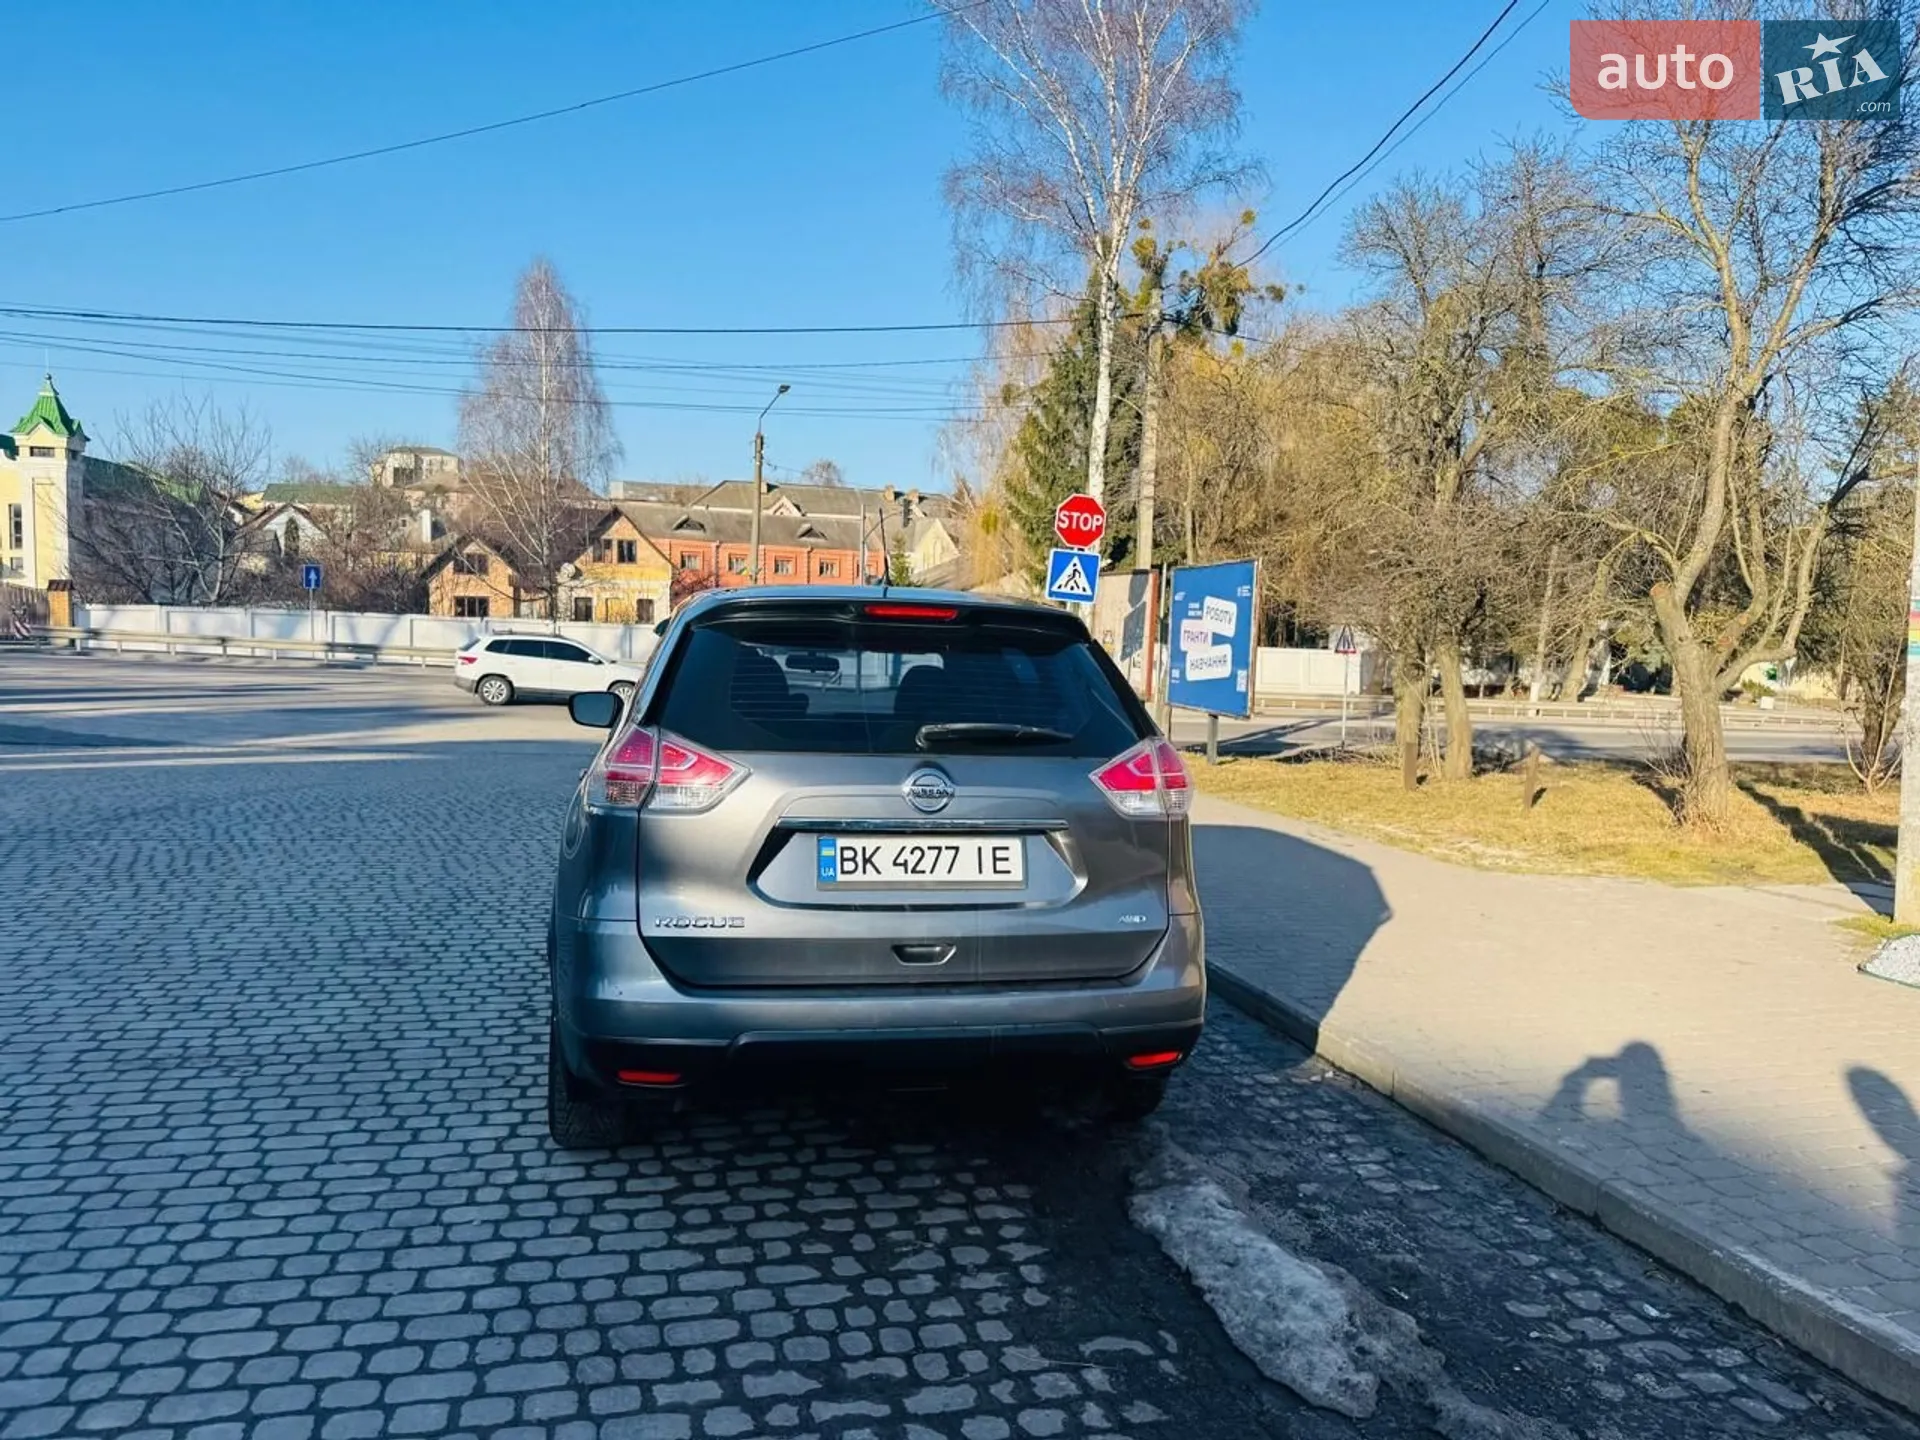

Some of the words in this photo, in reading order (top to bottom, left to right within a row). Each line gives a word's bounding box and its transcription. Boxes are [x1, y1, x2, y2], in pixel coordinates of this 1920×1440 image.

[1058, 510, 1103, 532] STOP
[892, 846, 960, 875] 4277
[820, 867, 835, 877] UA
[655, 915, 745, 928] ROGUE
